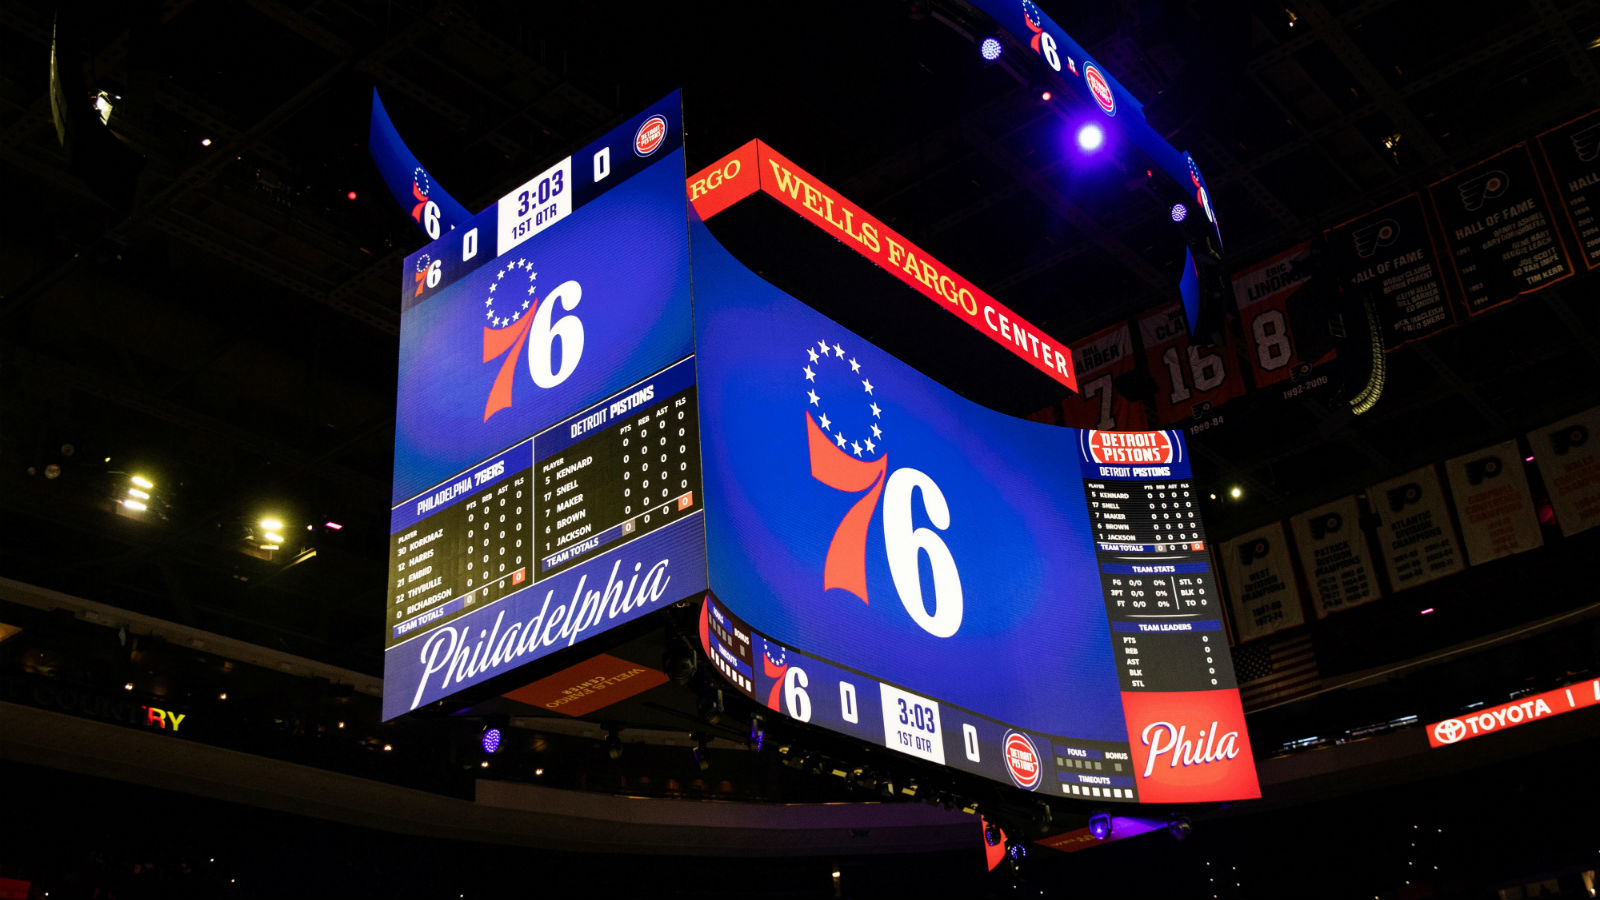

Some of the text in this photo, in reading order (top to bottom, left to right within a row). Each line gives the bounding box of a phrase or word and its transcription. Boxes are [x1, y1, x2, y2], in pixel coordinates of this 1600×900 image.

[593, 146, 611, 183] 0
[689, 159, 741, 202] RGO
[1568, 171, 1600, 193] HALL
[516, 169, 564, 218] 3:03
[511, 202, 558, 240] 1ST QTR
[1455, 220, 1485, 241] HALL
[1485, 212, 1500, 227] OF
[1502, 198, 1536, 221] FAME
[462, 227, 478, 262] 0
[1376, 261, 1392, 275] OF
[1393, 248, 1424, 270] FAME
[768, 158, 1069, 379] WELLS FARGO CENTER
[1526, 274, 1542, 284] TIM
[1156, 317, 1185, 341] CLA
[1251, 308, 1293, 372] 8
[482, 279, 585, 422] 76
[1076, 344, 1120, 375] ARBER
[1163, 344, 1226, 405] 16
[570, 384, 655, 439] DETROIT PISTONS
[1082, 373, 1116, 431] 7
[543, 397, 686, 474] PLAYER PTS REB AST FLS
[1099, 432, 1156, 447] DETROIT
[545, 456, 592, 486] 5 KENNARD
[1099, 466, 1171, 477] DETROIT PISTONS
[1102, 447, 1162, 462] PISTONS
[417, 460, 505, 516] PHILADELPHIA 76ERS
[466, 500, 476, 511] PTS
[498, 484, 508, 496] AST
[514, 476, 524, 488] FLS
[544, 480, 579, 502] 17 SNELL
[545, 494, 584, 518] 7 MAKER
[545, 509, 586, 534] 6 BROWN
[410, 528, 444, 552] KORKMAZ
[469, 514, 474, 522] 0
[484, 506, 489, 514] 0
[546, 497, 688, 568] TEAM TOTALS 0 0 0 0
[556, 524, 592, 547] JACKSON
[805, 410, 963, 639] 76
[408, 549, 434, 567] HARRIS
[396, 576, 442, 604] 22 THYBULLE
[397, 566, 432, 588] 21 EMBIID
[396, 588, 452, 619] 0 RICHARDSON
[397, 620, 418, 635] TEAM
[418, 608, 444, 626] TOTALS
[467, 595, 472, 603] 0
[483, 588, 488, 596] 0
[499, 580, 504, 588] 0
[409, 558, 671, 711] Philadelphia
[545, 668, 647, 709] WELLS FARGO
[561, 676, 606, 695] CENTER
[839, 680, 859, 724] 0
[897, 698, 936, 734] 3:03
[1465, 698, 1552, 734] TOYOTA
[897, 730, 932, 754] 1ST QTR
[962, 723, 980, 763] 0
[1010, 747, 1033, 763] DETROIT
[1067, 748, 1128, 760] FOULS BONUS
[1141, 721, 1240, 778] Phila
[1011, 758, 1034, 773] PISTONS
[1078, 775, 1111, 785] TIMEOUTS
